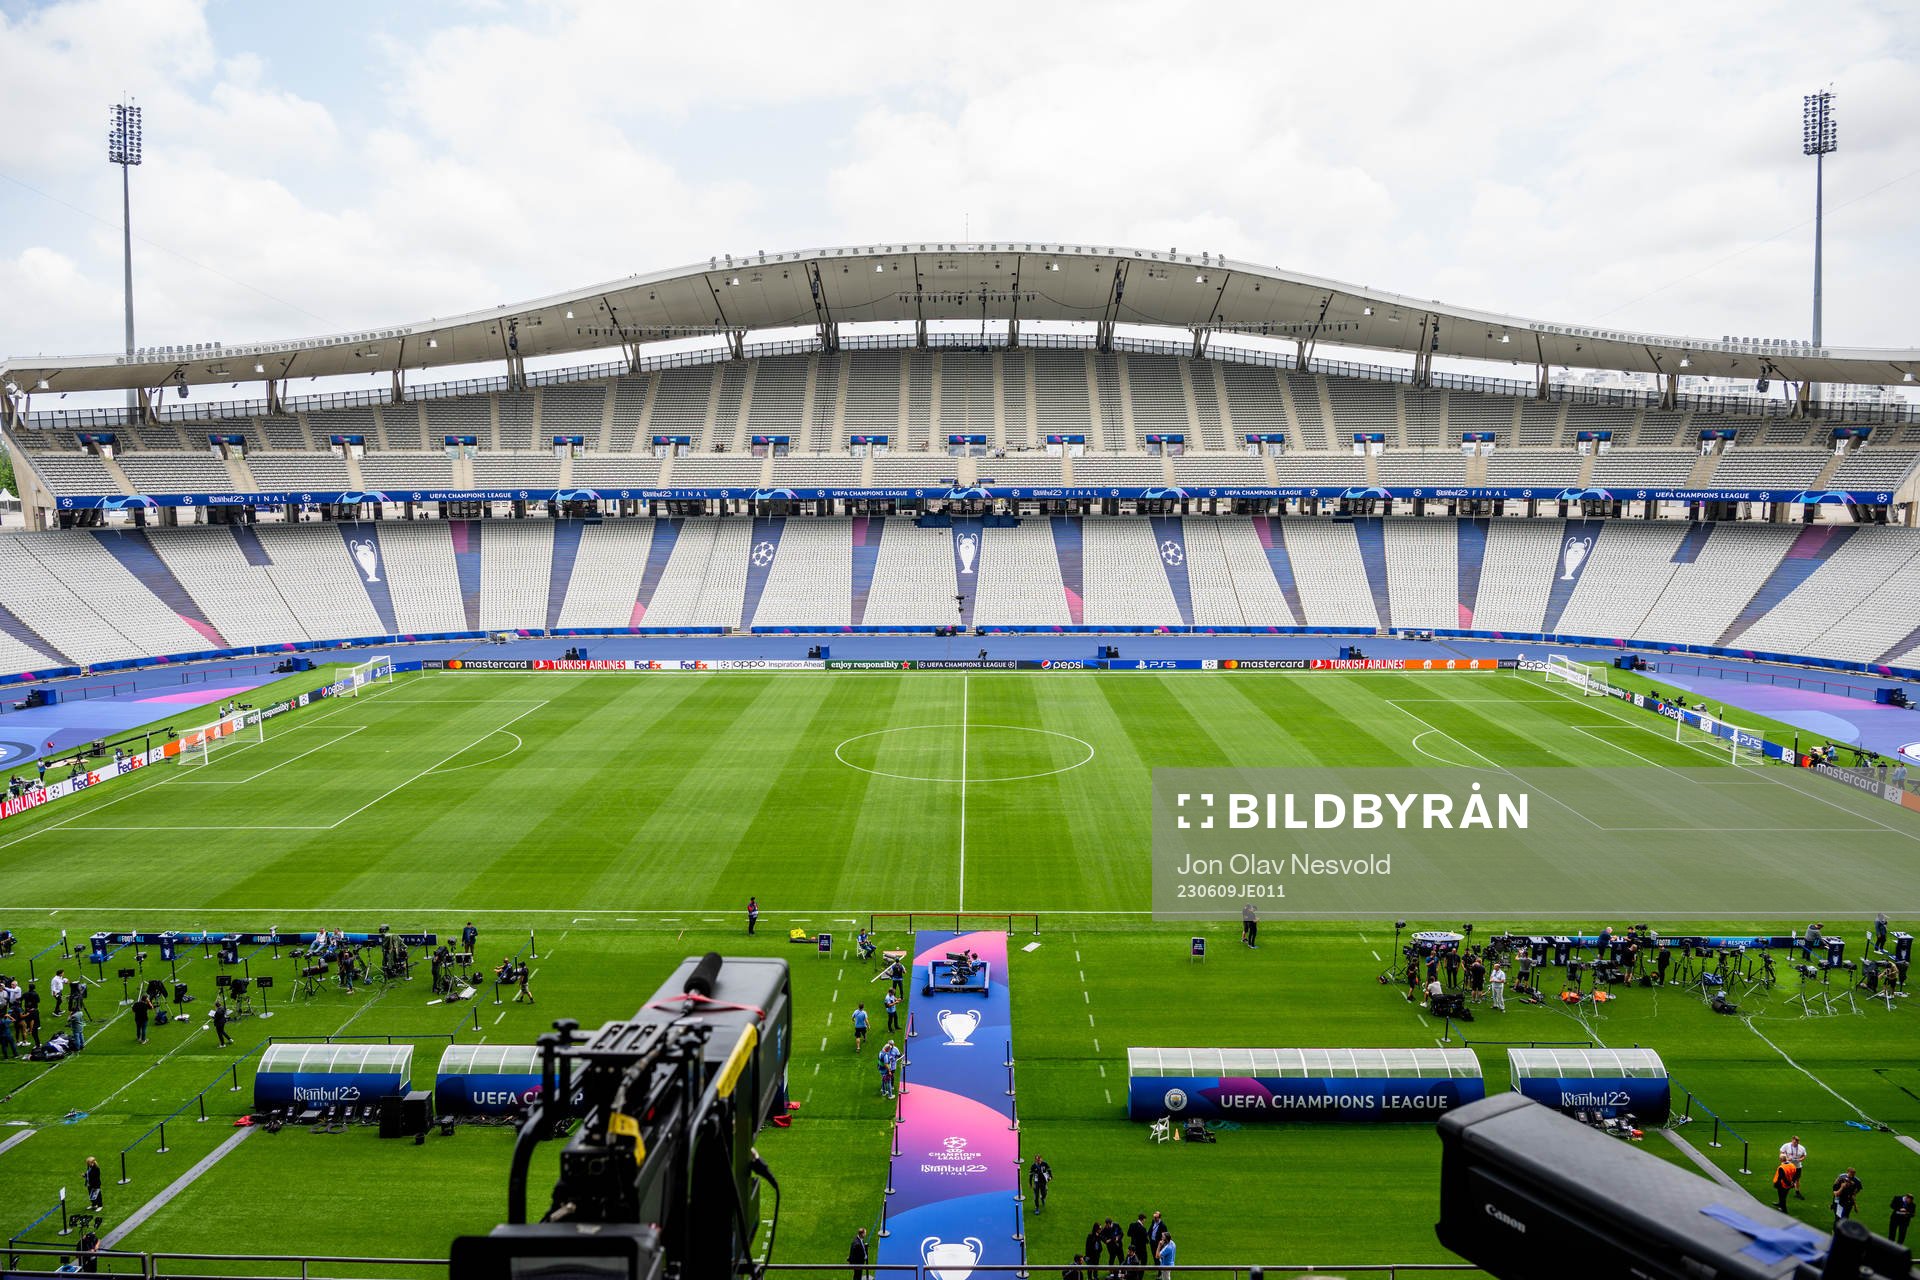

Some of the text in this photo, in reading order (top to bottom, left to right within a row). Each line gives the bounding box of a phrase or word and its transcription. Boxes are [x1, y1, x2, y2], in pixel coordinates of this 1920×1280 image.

[464, 660, 527, 668] mastercard
[552, 660, 625, 670] TURKISH AIRLINES
[634, 660, 662, 669] FedEx
[680, 660, 708, 669] FedEx
[733, 660, 766, 669] oppo
[768, 660, 802, 668] Inspiration
[831, 661, 898, 670] enjoy responsibly
[1053, 660, 1083, 669] pepsi
[1241, 660, 1304, 668] mastercard
[1330, 660, 1404, 669] TURKISH AIRLINES
[118, 756, 143, 774] FedEx
[72, 772, 100, 791] FedEx
[1816, 763, 1879, 794] mastercard
[6, 789, 46, 817] AIRLINES
[474, 1092, 518, 1104] UEFA
[1221, 1095, 1448, 1109] UEFA CHAMPIONS LEAGUE
[1485, 1204, 1526, 1232] Canon
